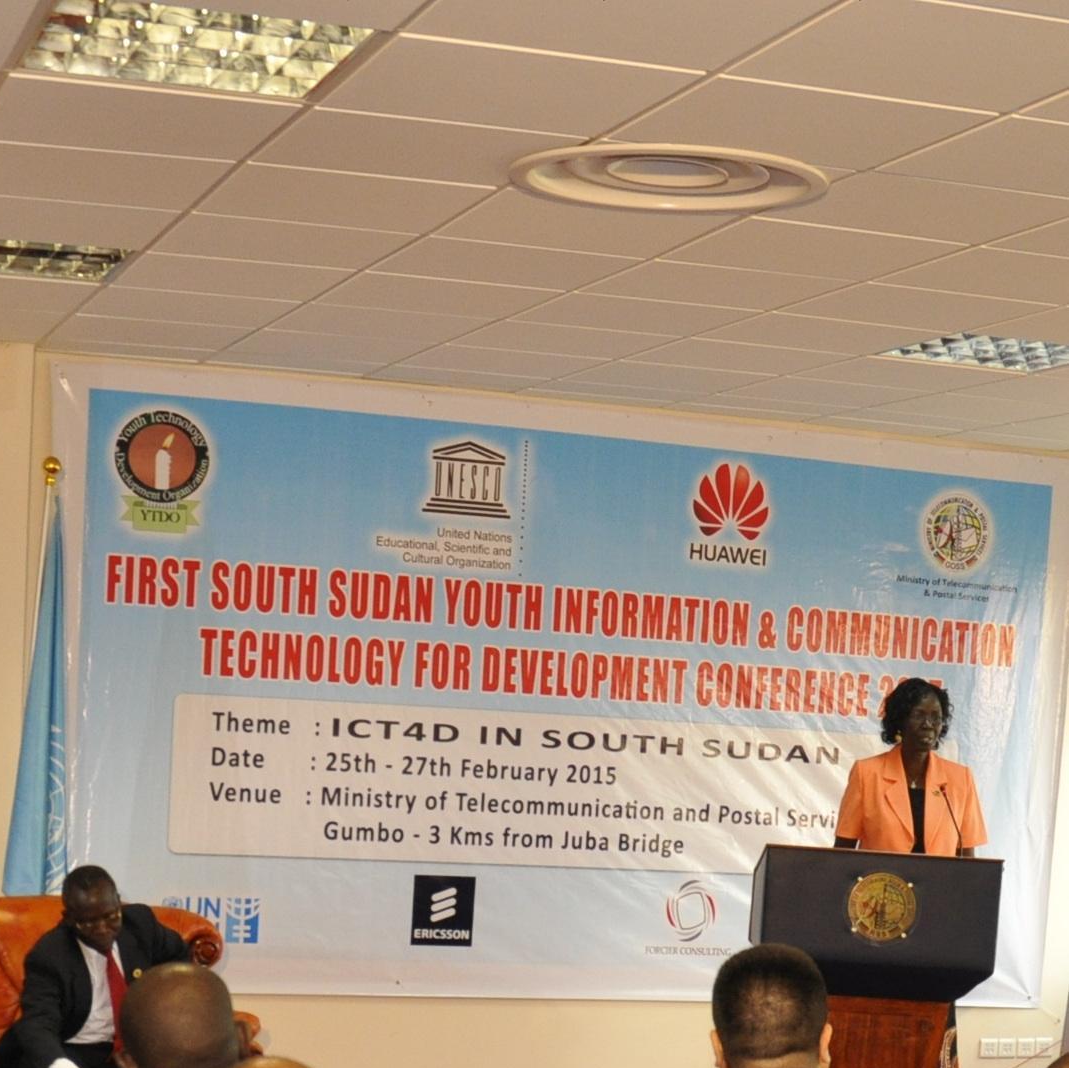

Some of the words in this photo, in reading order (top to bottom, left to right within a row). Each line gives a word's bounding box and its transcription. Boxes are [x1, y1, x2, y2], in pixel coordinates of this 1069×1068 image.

[120, 415, 148, 442] Youth
[151, 412, 207, 448] Technology
[434, 461, 502, 501] UNESCO
[140, 509, 181, 523] YTDO
[376, 536, 440, 551] Educational,
[444, 541, 490, 555] Scientific
[493, 546, 512, 557] and
[437, 528, 470, 540] United
[474, 530, 512, 543] Nations
[403, 552, 443, 565] Cultural
[446, 555, 511, 570] Organization
[690, 542, 767, 566] HUAWEI
[896, 575, 929, 587] Ministry
[931, 577, 941, 586] of
[943, 579, 1018, 593] Telecommunication
[923, 589, 931, 597] &
[932, 590, 955, 600] Postal
[959, 592, 990, 603] Services
[106, 554, 201, 608] FIRST
[210, 561, 318, 616] SOUTH
[328, 570, 433, 623] SUDAN
[445, 578, 544, 631] YOUTH
[552, 587, 750, 647] INFORMATION
[758, 611, 777, 649] &
[787, 606, 1017, 667] COMMUNICATION
[200, 628, 405, 686] TECHNOLOGY
[414, 642, 471, 691] FOR
[482, 646, 688, 704] DEVELOPMENT
[697, 661, 870, 717] CONFERENCE
[212, 711, 291, 734] Theme
[332, 717, 460, 742] ICT4D
[479, 726, 523, 747] IN
[541, 730, 684, 756] SOUTH
[702, 739, 840, 764] SUDAN
[211, 747, 265, 768] Date
[326, 752, 376, 773] 25th
[402, 756, 452, 777] 27th
[461, 759, 558, 787] February
[566, 764, 617, 785] 2015
[209, 782, 282, 804] Venue
[321, 787, 417, 814] Ministry
[424, 790, 448, 811] of
[456, 792, 665, 821] Telecommunication
[673, 803, 711, 824] and
[718, 805, 780, 826] Postal
[786, 808, 835, 829] Servi
[324, 821, 404, 843] Gumbo
[429, 825, 441, 845] 3
[450, 826, 494, 847] Kms
[502, 827, 553, 849] from
[561, 830, 609, 852] Juba
[618, 833, 684, 858] Bridge
[413, 929, 470, 940] ERICSSON
[679, 946, 732, 957] CONSULTING
